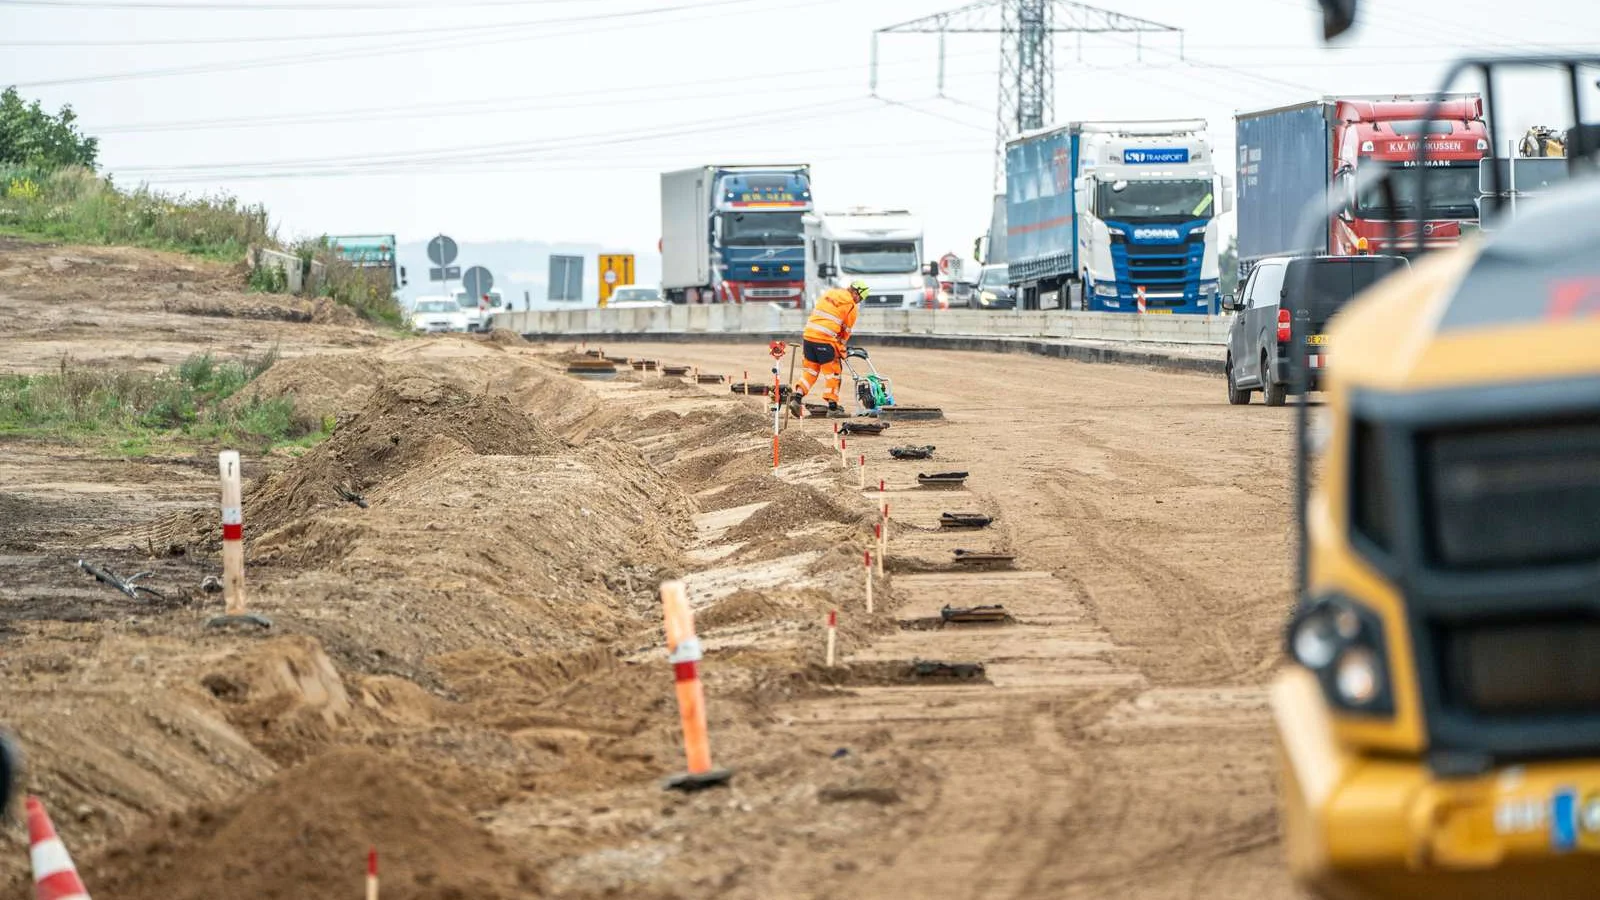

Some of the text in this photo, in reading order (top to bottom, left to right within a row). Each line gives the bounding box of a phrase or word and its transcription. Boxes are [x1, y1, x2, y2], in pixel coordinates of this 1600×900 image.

[1408, 142, 1461, 151] MAKUSSEN
[1146, 154, 1184, 162] TRANSPORT
[1134, 229, 1180, 239] SCANIA
